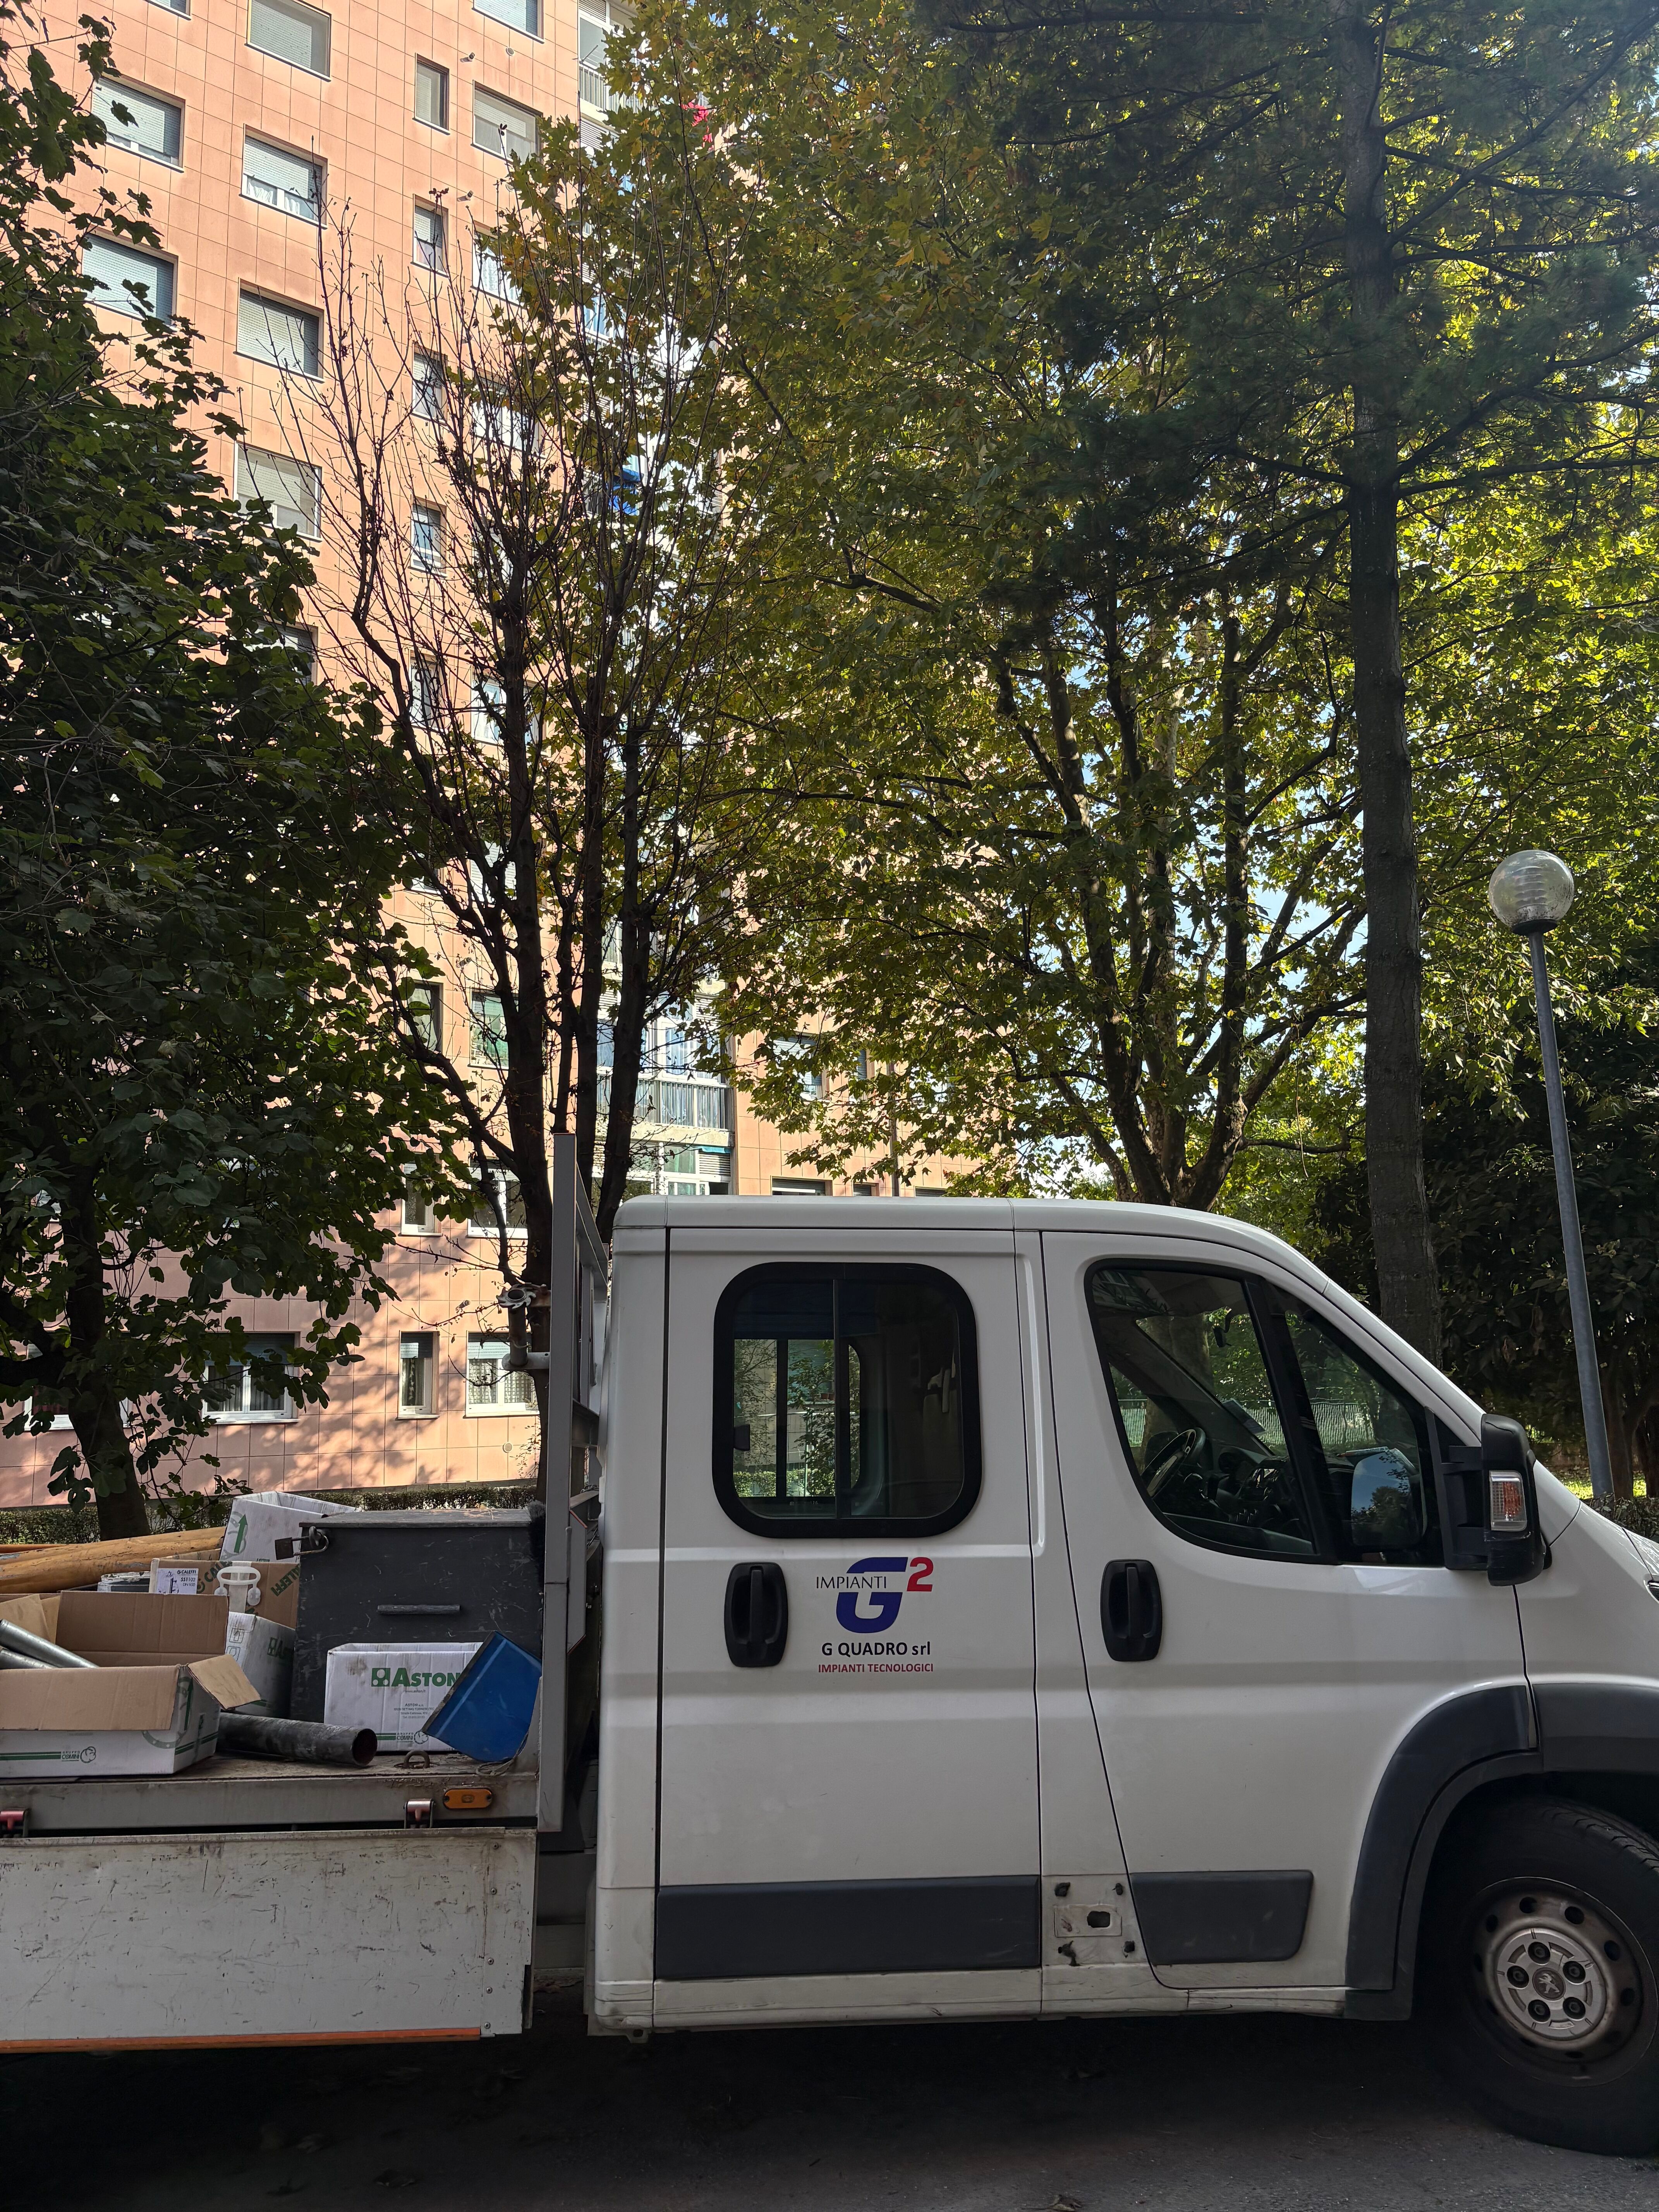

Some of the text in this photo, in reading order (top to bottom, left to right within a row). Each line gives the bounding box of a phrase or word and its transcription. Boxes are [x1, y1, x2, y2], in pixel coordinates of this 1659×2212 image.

[271, 1564, 300, 1597] ALEFFI
[816, 1576, 886, 1589] IMPIANTI
[821, 1641, 930, 1657] G QUADRO srl
[818, 1663, 933, 1673] IMPIANTI TECNOLOGICI
[391, 1668, 461, 1687] ASTON
